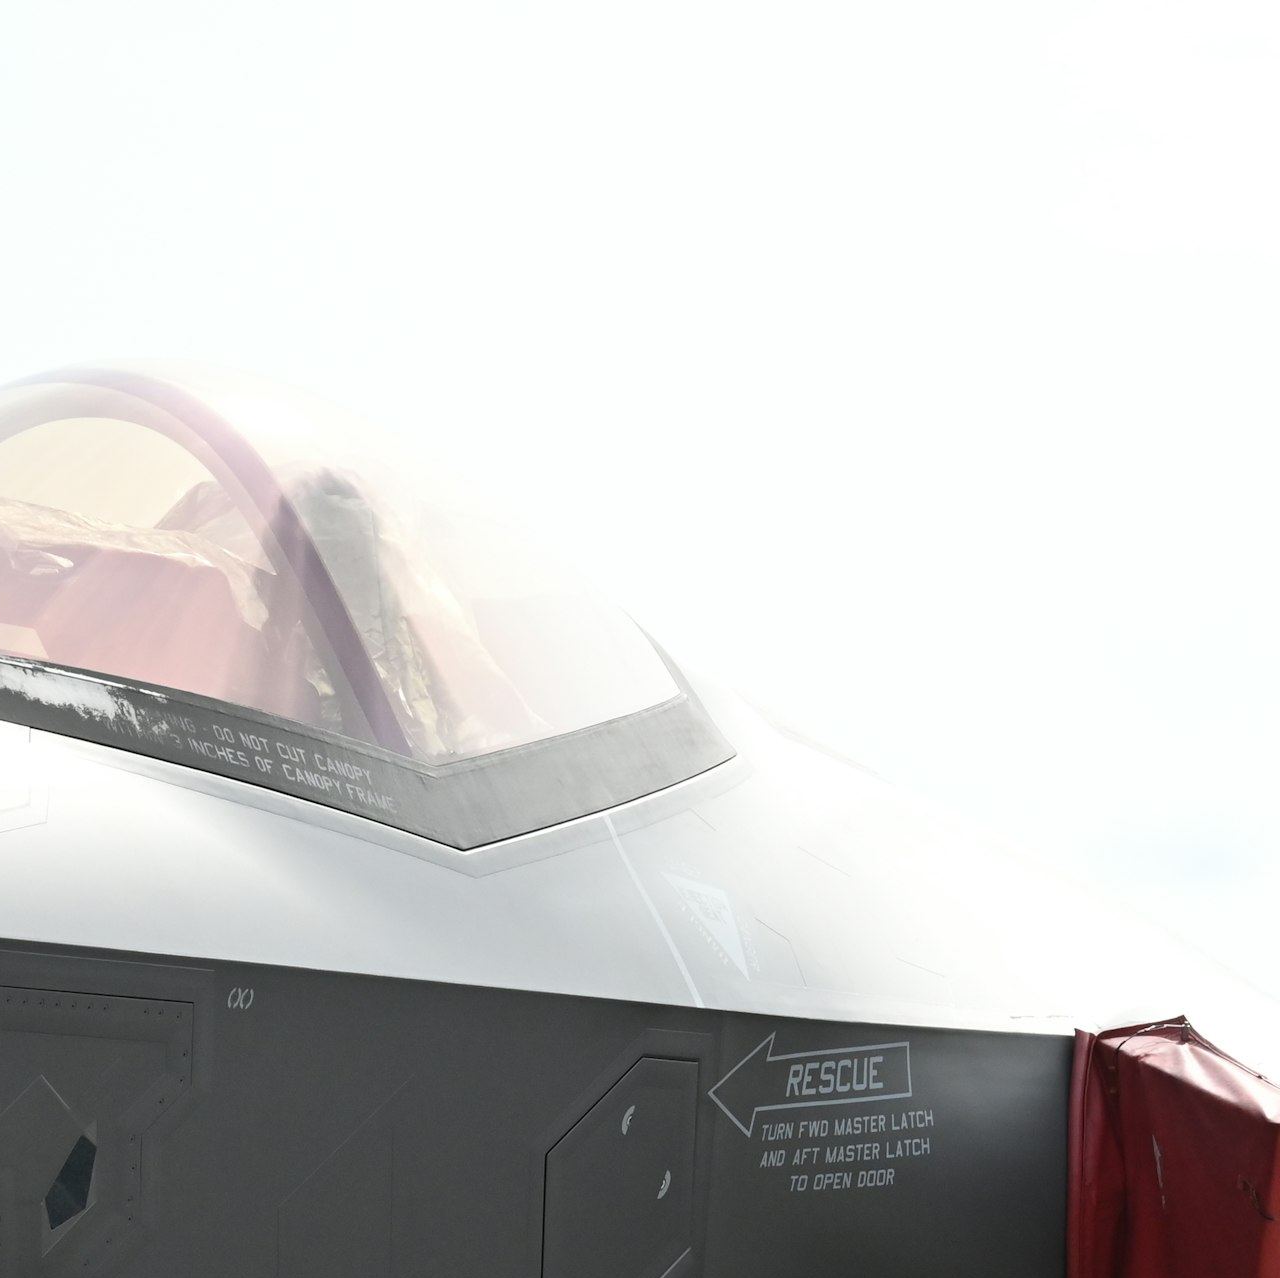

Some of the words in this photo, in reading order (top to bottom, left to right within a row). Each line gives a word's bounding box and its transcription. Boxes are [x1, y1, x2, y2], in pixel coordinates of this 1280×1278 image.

[212, 724, 235, 744] DO
[239, 731, 269, 755] NOT
[276, 742, 307, 765] CUT
[316, 753, 374, 786] CANOPY
[187, 737, 251, 768] INCHES
[255, 756, 273, 775] OF
[282, 764, 343, 796] CANOPY
[346, 783, 397, 813] FRAME
[785, 1055, 884, 1098] RESCUE
[761, 1122, 793, 1142] TURN
[798, 1119, 829, 1138] FWD
[834, 1114, 886, 1137] MASTER
[891, 1110, 934, 1130] LATCH
[759, 1148, 785, 1168] AND
[792, 1147, 820, 1166] AFT
[825, 1143, 880, 1164] MASTER
[885, 1138, 931, 1158] LATCH
[789, 1175, 807, 1192] TO
[813, 1171, 853, 1190] OPEN
[857, 1169, 895, 1188] DOOR
